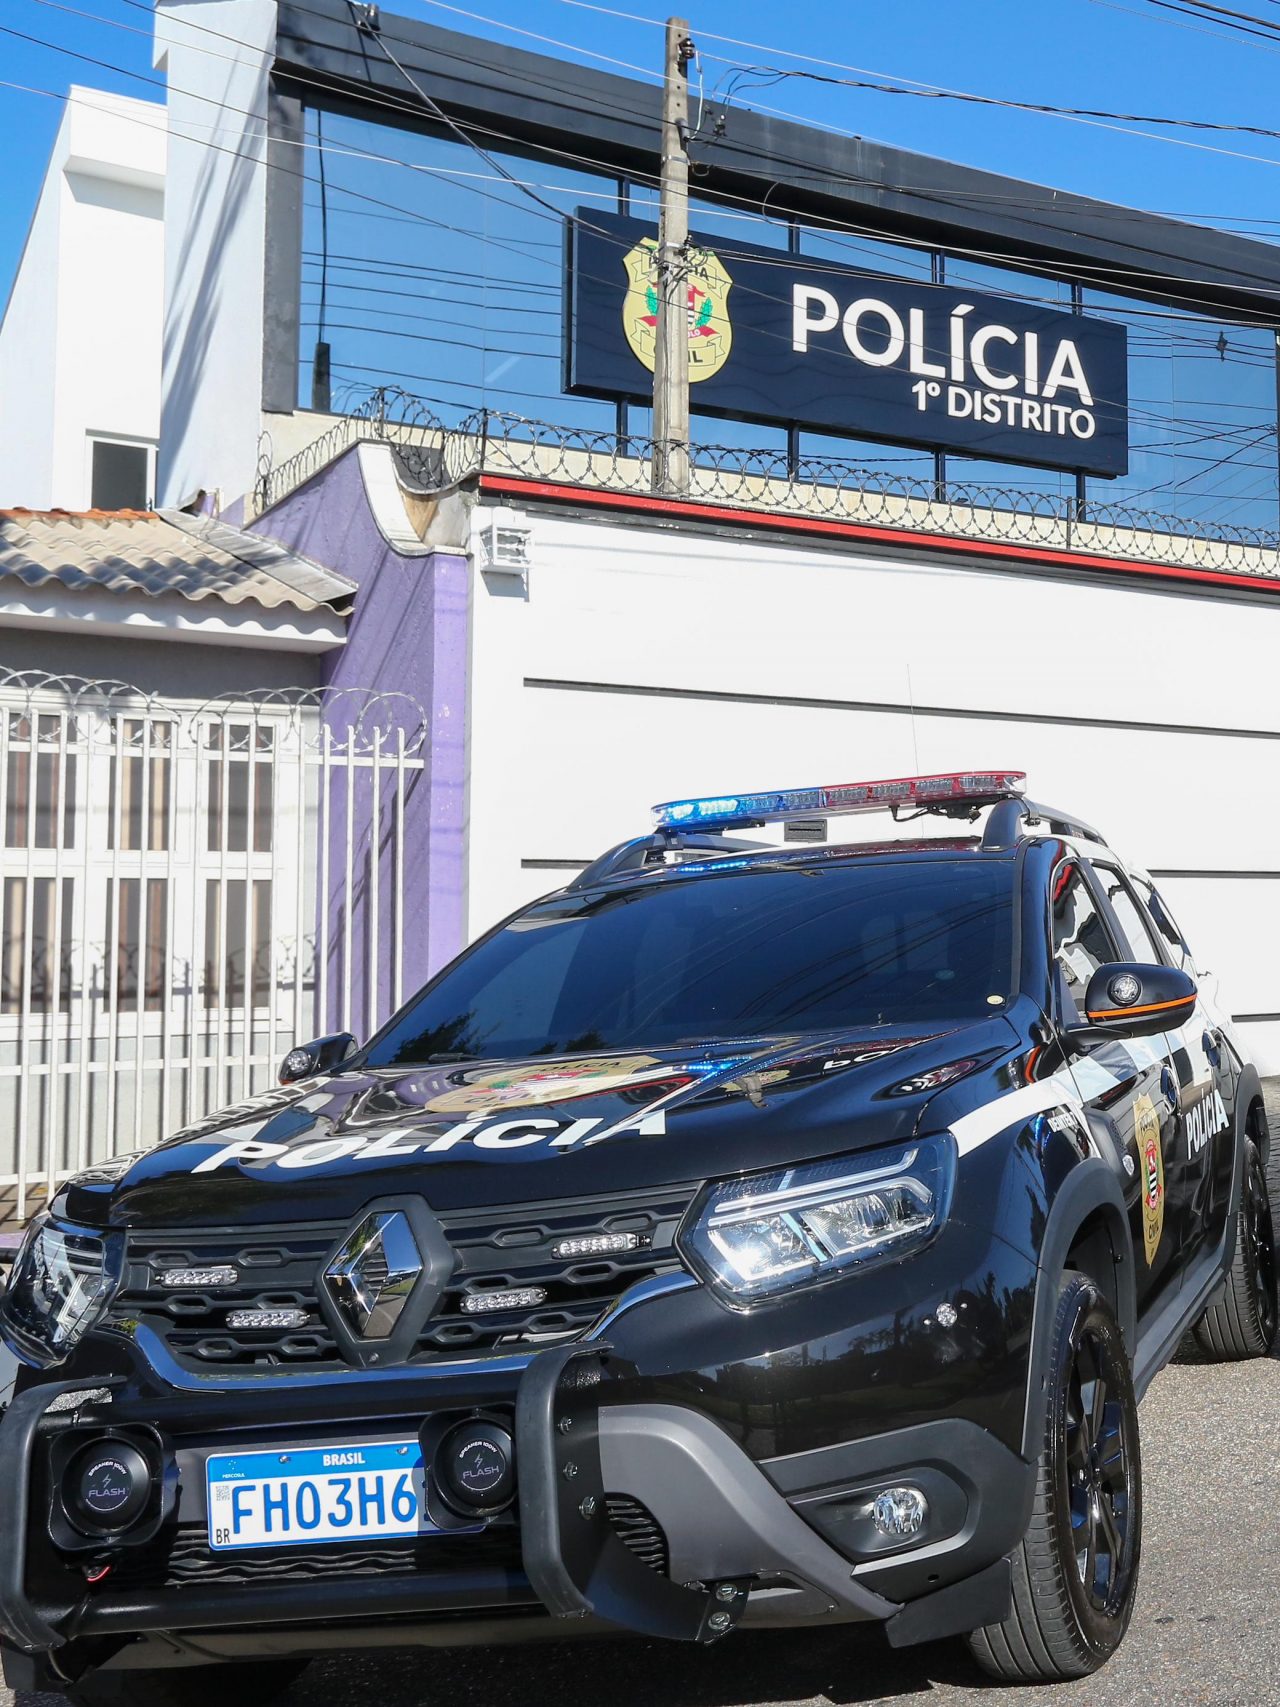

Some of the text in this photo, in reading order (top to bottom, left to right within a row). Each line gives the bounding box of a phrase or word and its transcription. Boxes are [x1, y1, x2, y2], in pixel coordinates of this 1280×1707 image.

[792, 283, 1094, 406] POLÍCIA
[948, 386, 1095, 440] DISTRITO
[192, 1109, 666, 1173] POLÍCIA
[1185, 1088, 1230, 1160] POLÍCIA
[323, 1452, 366, 1467] BRASIL
[462, 1465, 500, 1479] FLASH
[88, 1487, 126, 1498] FLASH
[216, 1528, 230, 1544] BR
